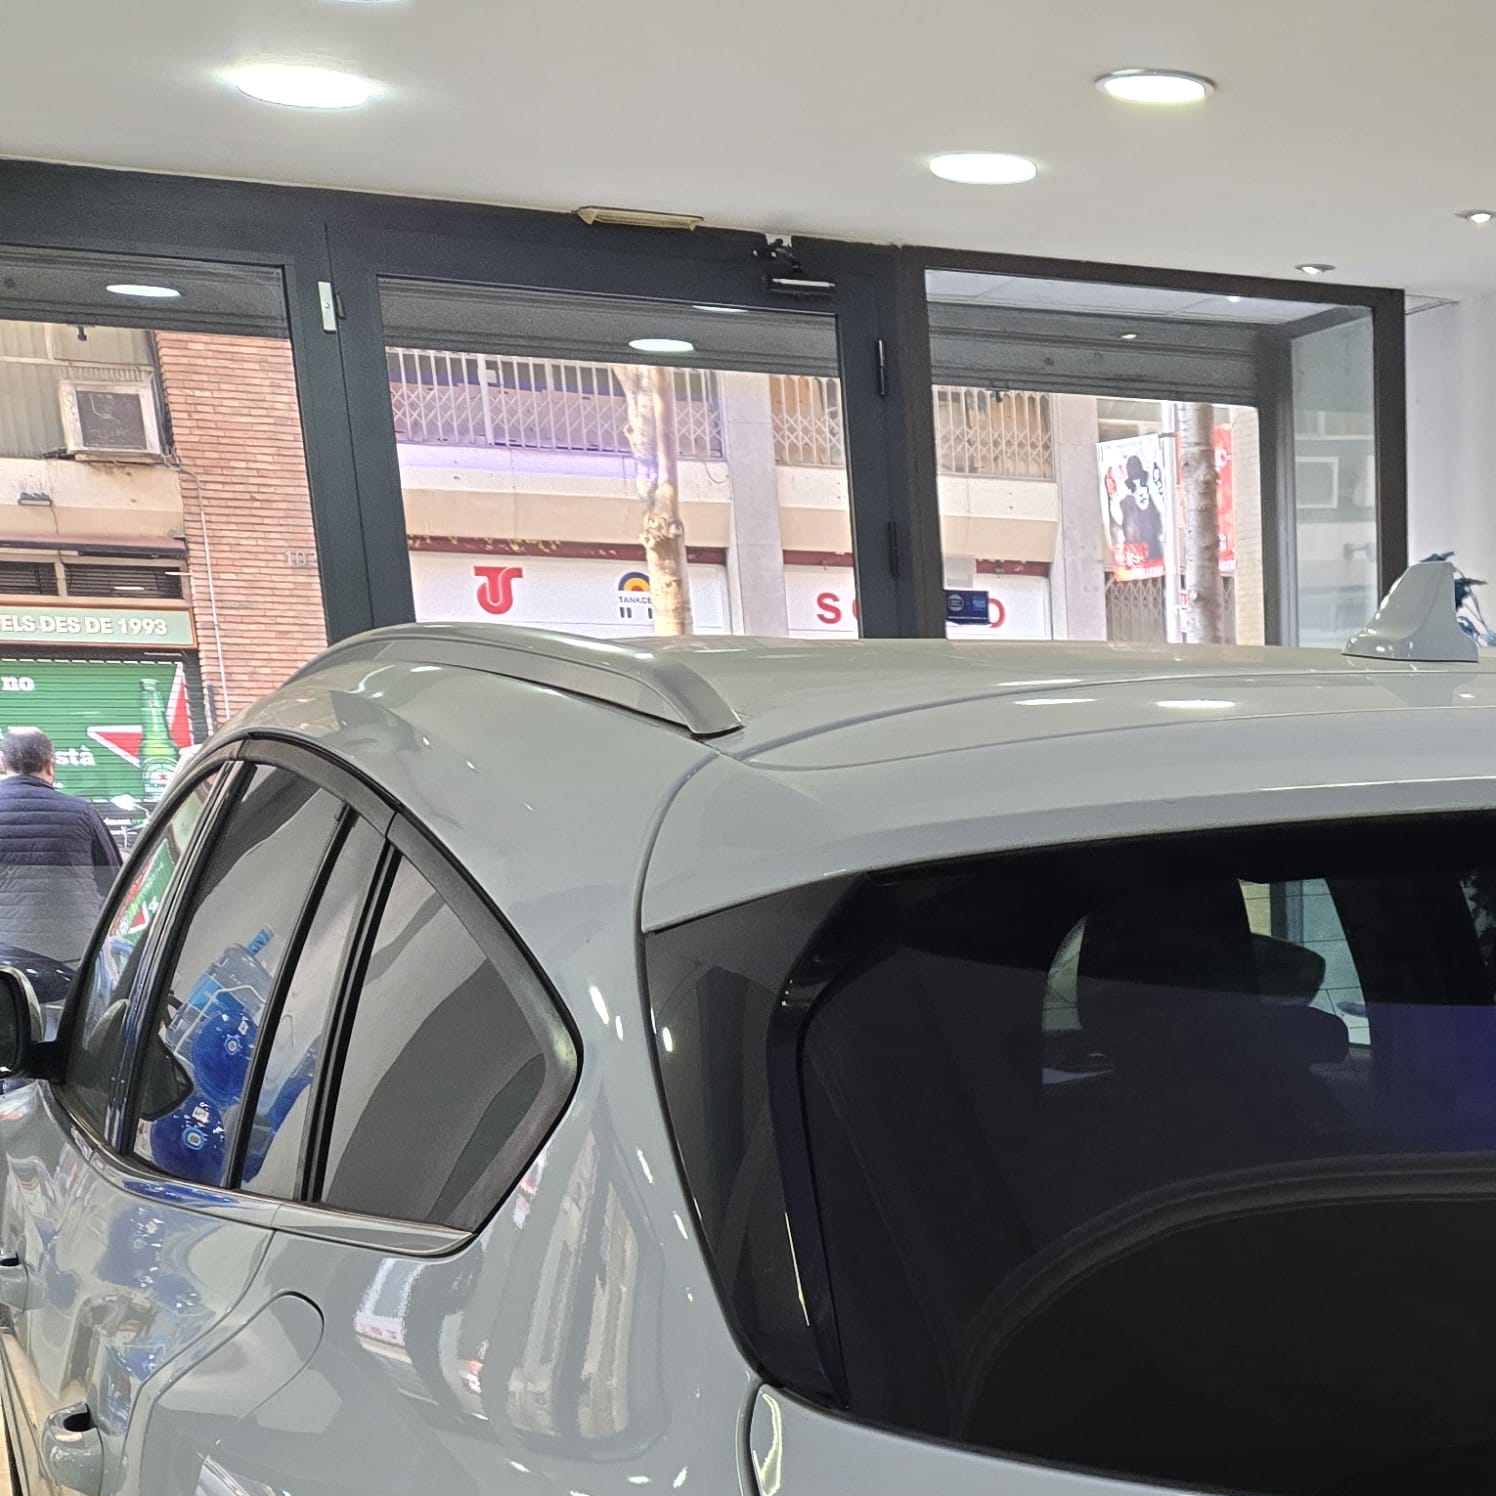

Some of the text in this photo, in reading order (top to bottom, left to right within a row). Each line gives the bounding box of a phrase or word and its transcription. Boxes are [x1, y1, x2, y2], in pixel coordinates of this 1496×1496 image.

[0, 614, 168, 636] ELS DES DE 1993
[1, 676, 35, 691] no
[55, 744, 97, 766] stà
